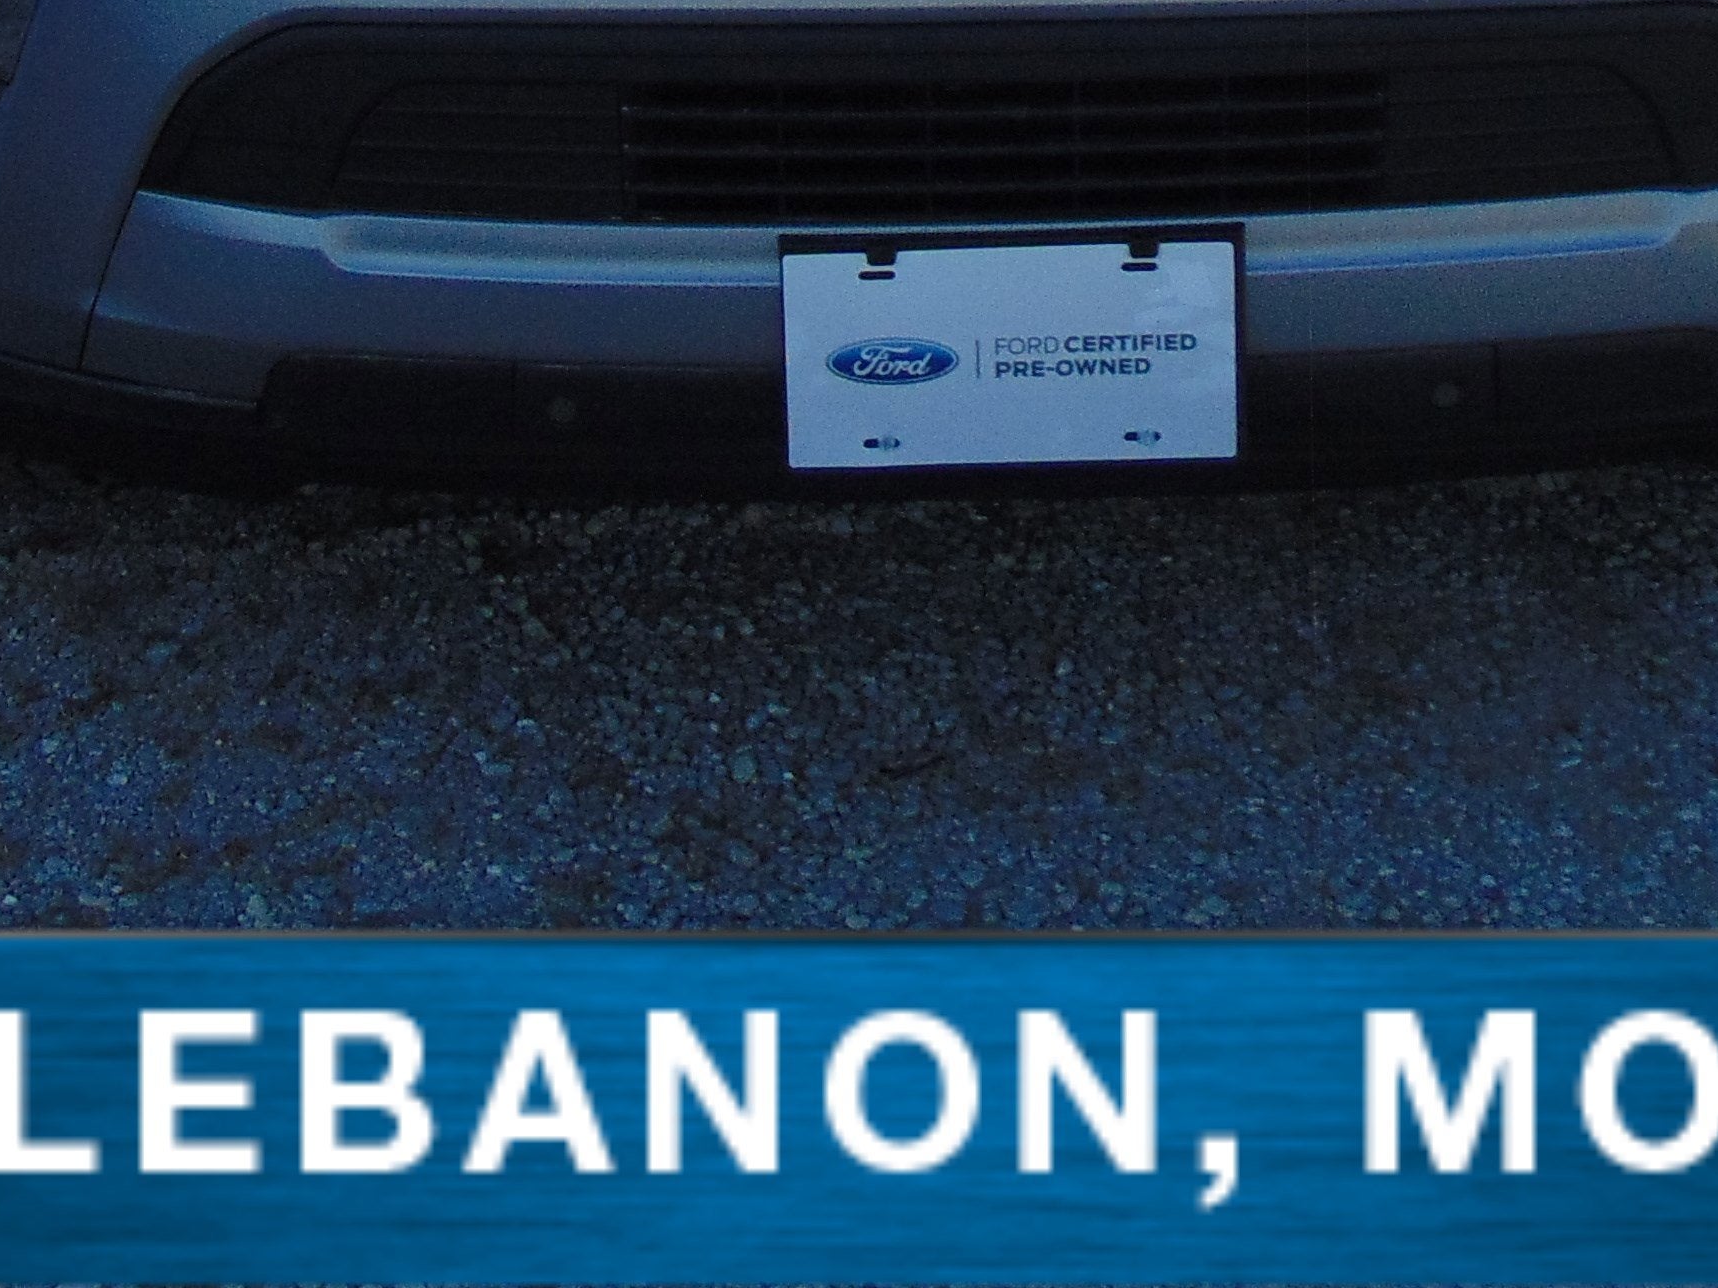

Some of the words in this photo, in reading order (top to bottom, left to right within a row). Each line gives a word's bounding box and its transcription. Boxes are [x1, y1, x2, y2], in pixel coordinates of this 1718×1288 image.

[852, 345, 931, 378] Ford
[994, 336, 1060, 356] FORD
[1063, 333, 1198, 353] CERTIFIED
[994, 357, 1151, 379] PRE-OWNED
